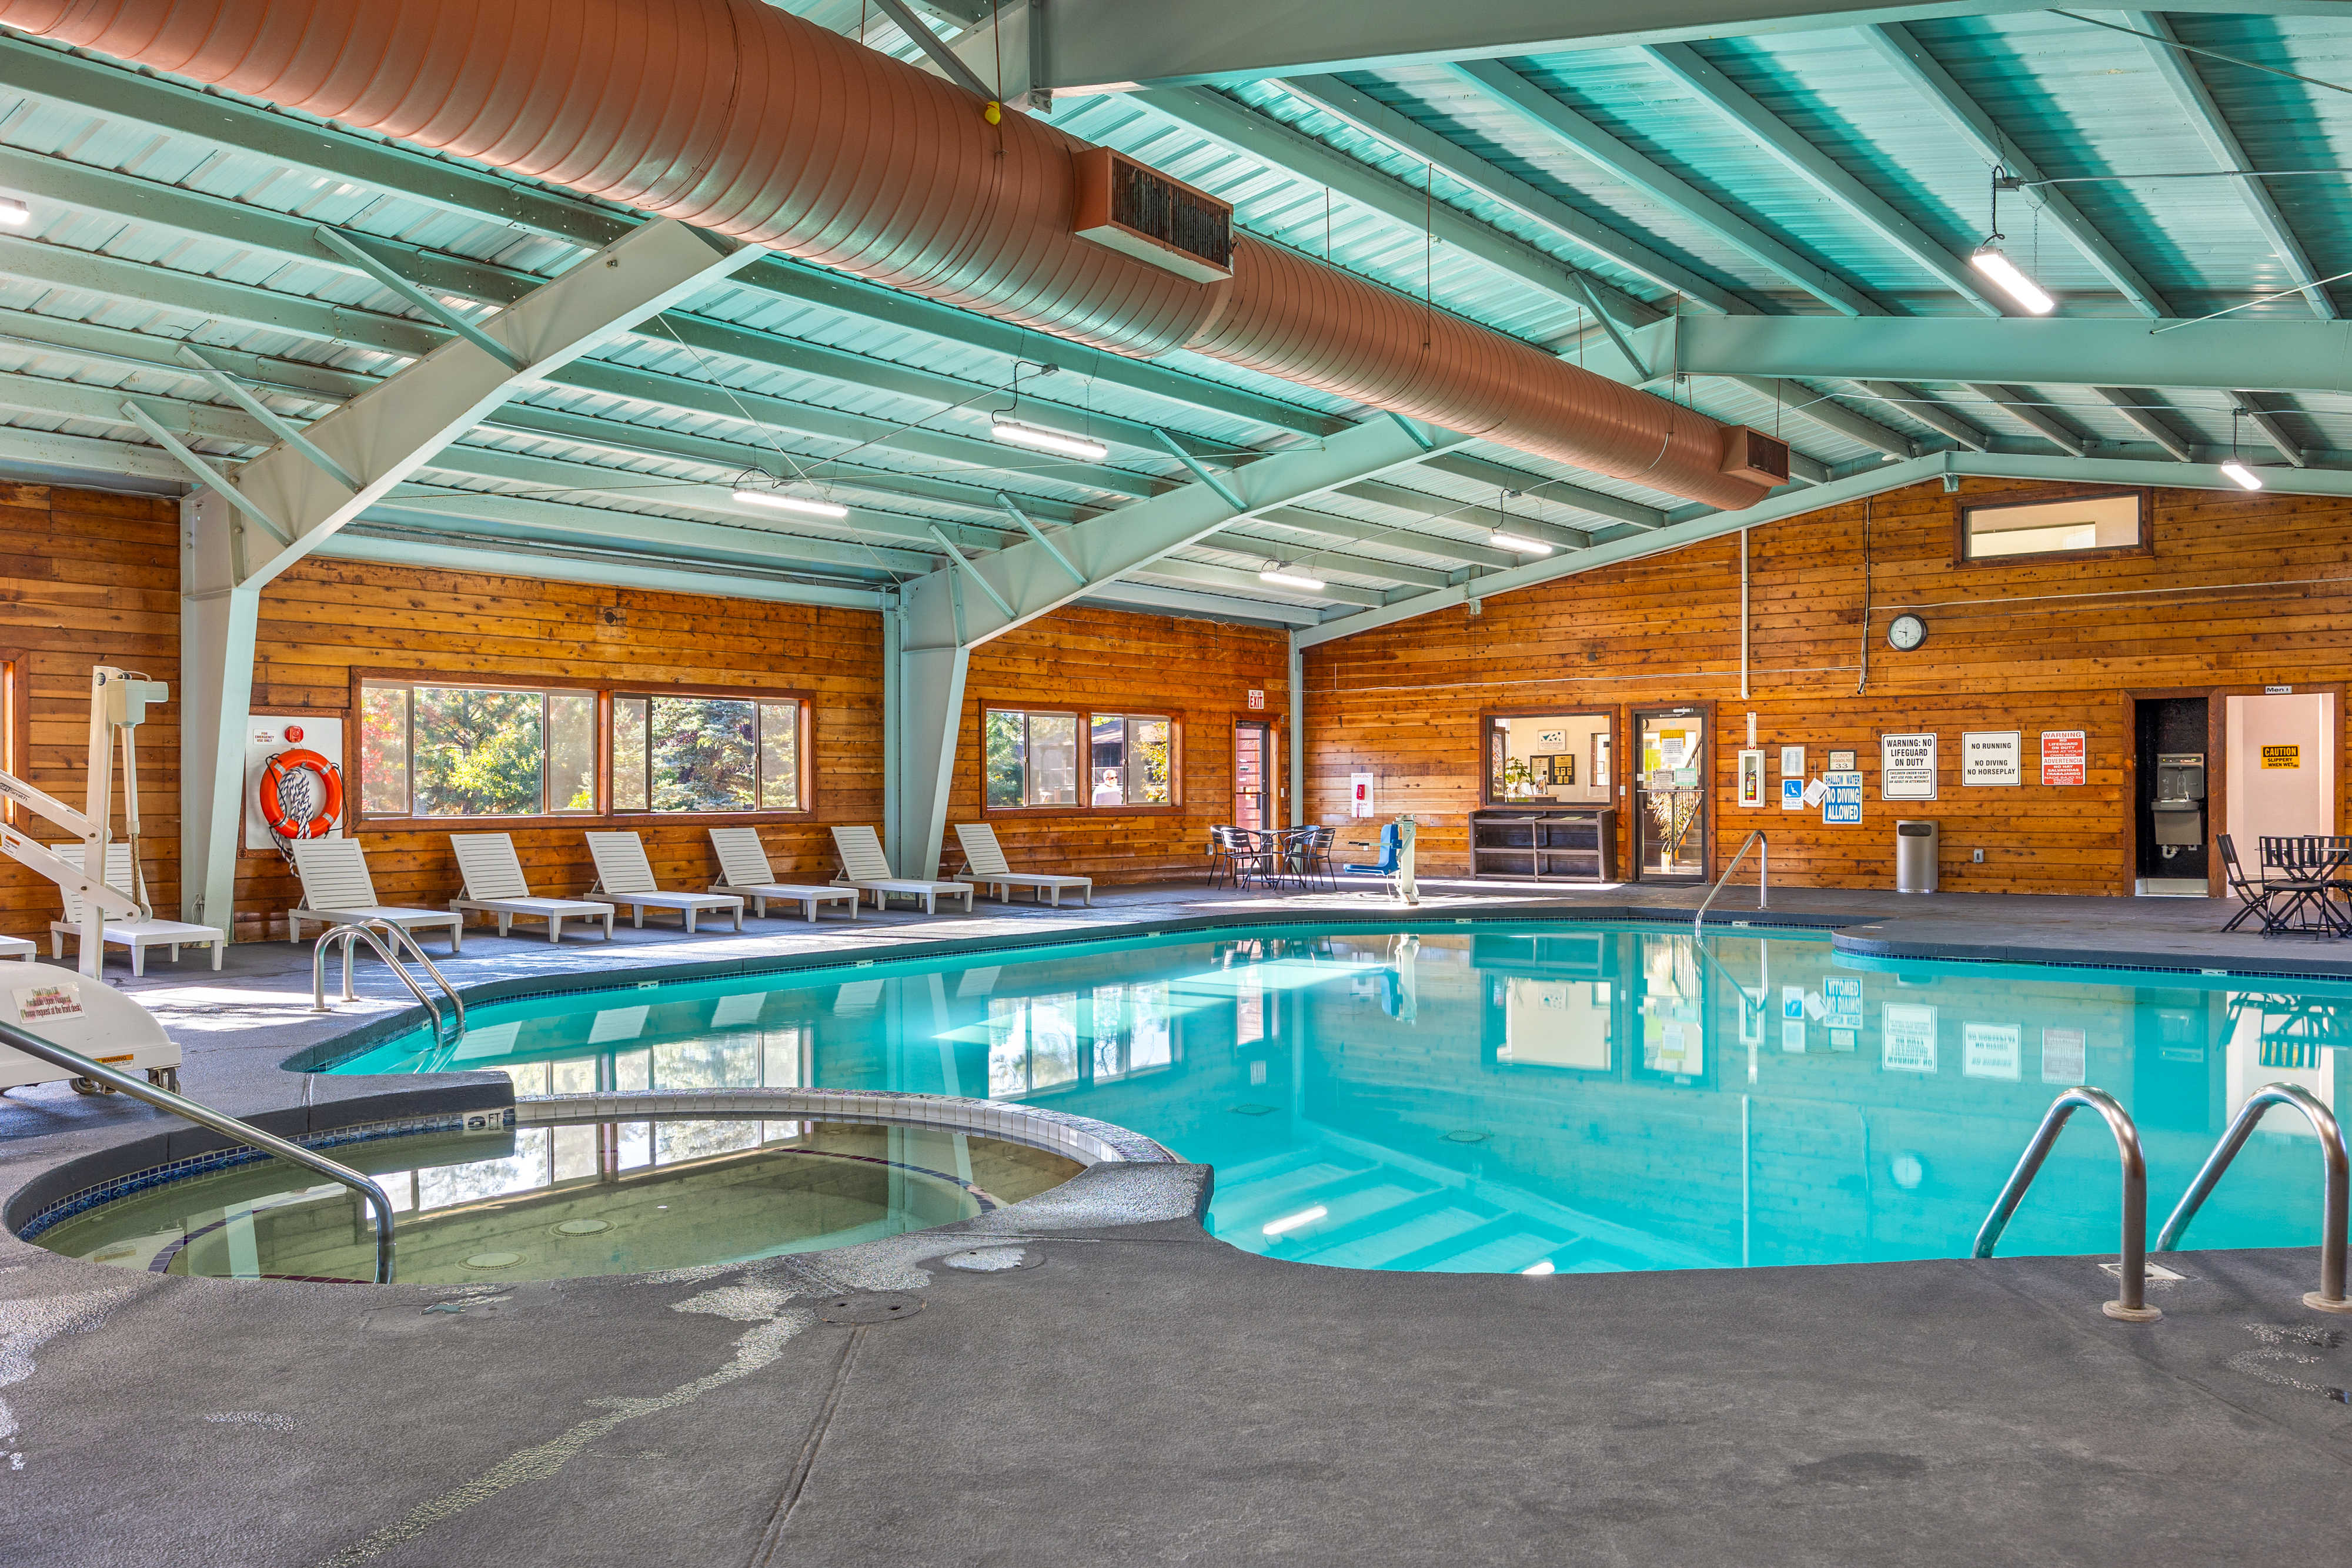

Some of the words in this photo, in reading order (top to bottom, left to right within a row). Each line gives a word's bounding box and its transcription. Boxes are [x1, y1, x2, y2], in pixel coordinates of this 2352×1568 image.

[1250, 696, 1262, 708] EXIT
[1887, 739, 1920, 747] WARNING:
[1923, 738, 1932, 747] NO
[1891, 748, 1927, 757] LIFEGUARD
[2264, 747, 2296, 756] CAUTION
[1826, 775, 1843, 785] SHALLOW
[1846, 775, 1860, 785] WATER
[9, 788, 28, 801] Smith
[1826, 788, 1836, 803] NO
[1837, 788, 1860, 803] DIVING
[1828, 805, 1859, 820] ALLOWED
[26, 998, 44, 1007] Available
[44, 997, 55, 1007] Upon
[56, 995, 72, 1005] Request
[36, 1007, 51, 1018] request
[51, 1007, 56, 1015] at
[61, 1005, 71, 1013] front
[71, 1003, 82, 1012] desk)
